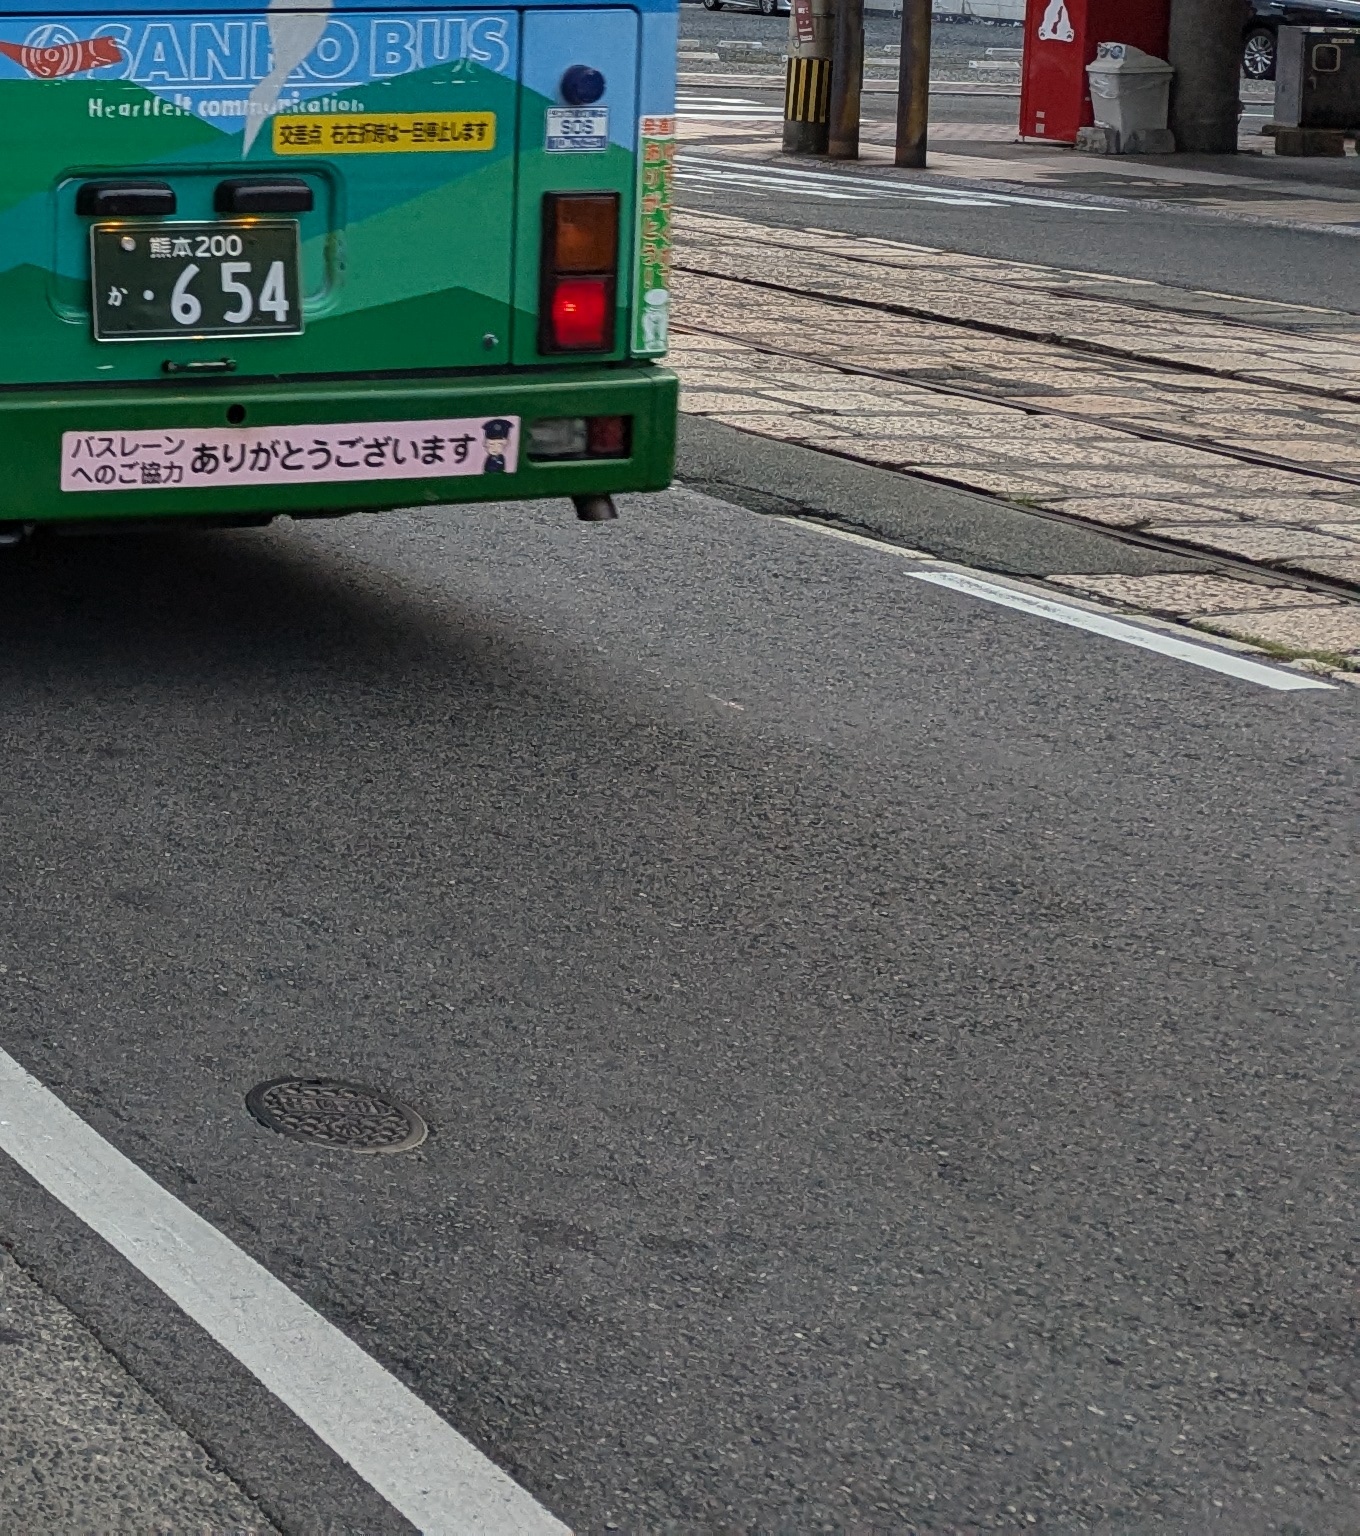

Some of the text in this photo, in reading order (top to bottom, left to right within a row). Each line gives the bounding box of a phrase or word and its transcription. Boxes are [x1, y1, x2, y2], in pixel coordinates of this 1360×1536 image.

[369, 16, 510, 78] BUS
[88, 93, 193, 118] Heartfelt
[107, 285, 129, 307] か
[70, 435, 187, 459] バスレーン
[189, 432, 479, 475] ありがとうございます
[70, 461, 185, 485] へのご協力
